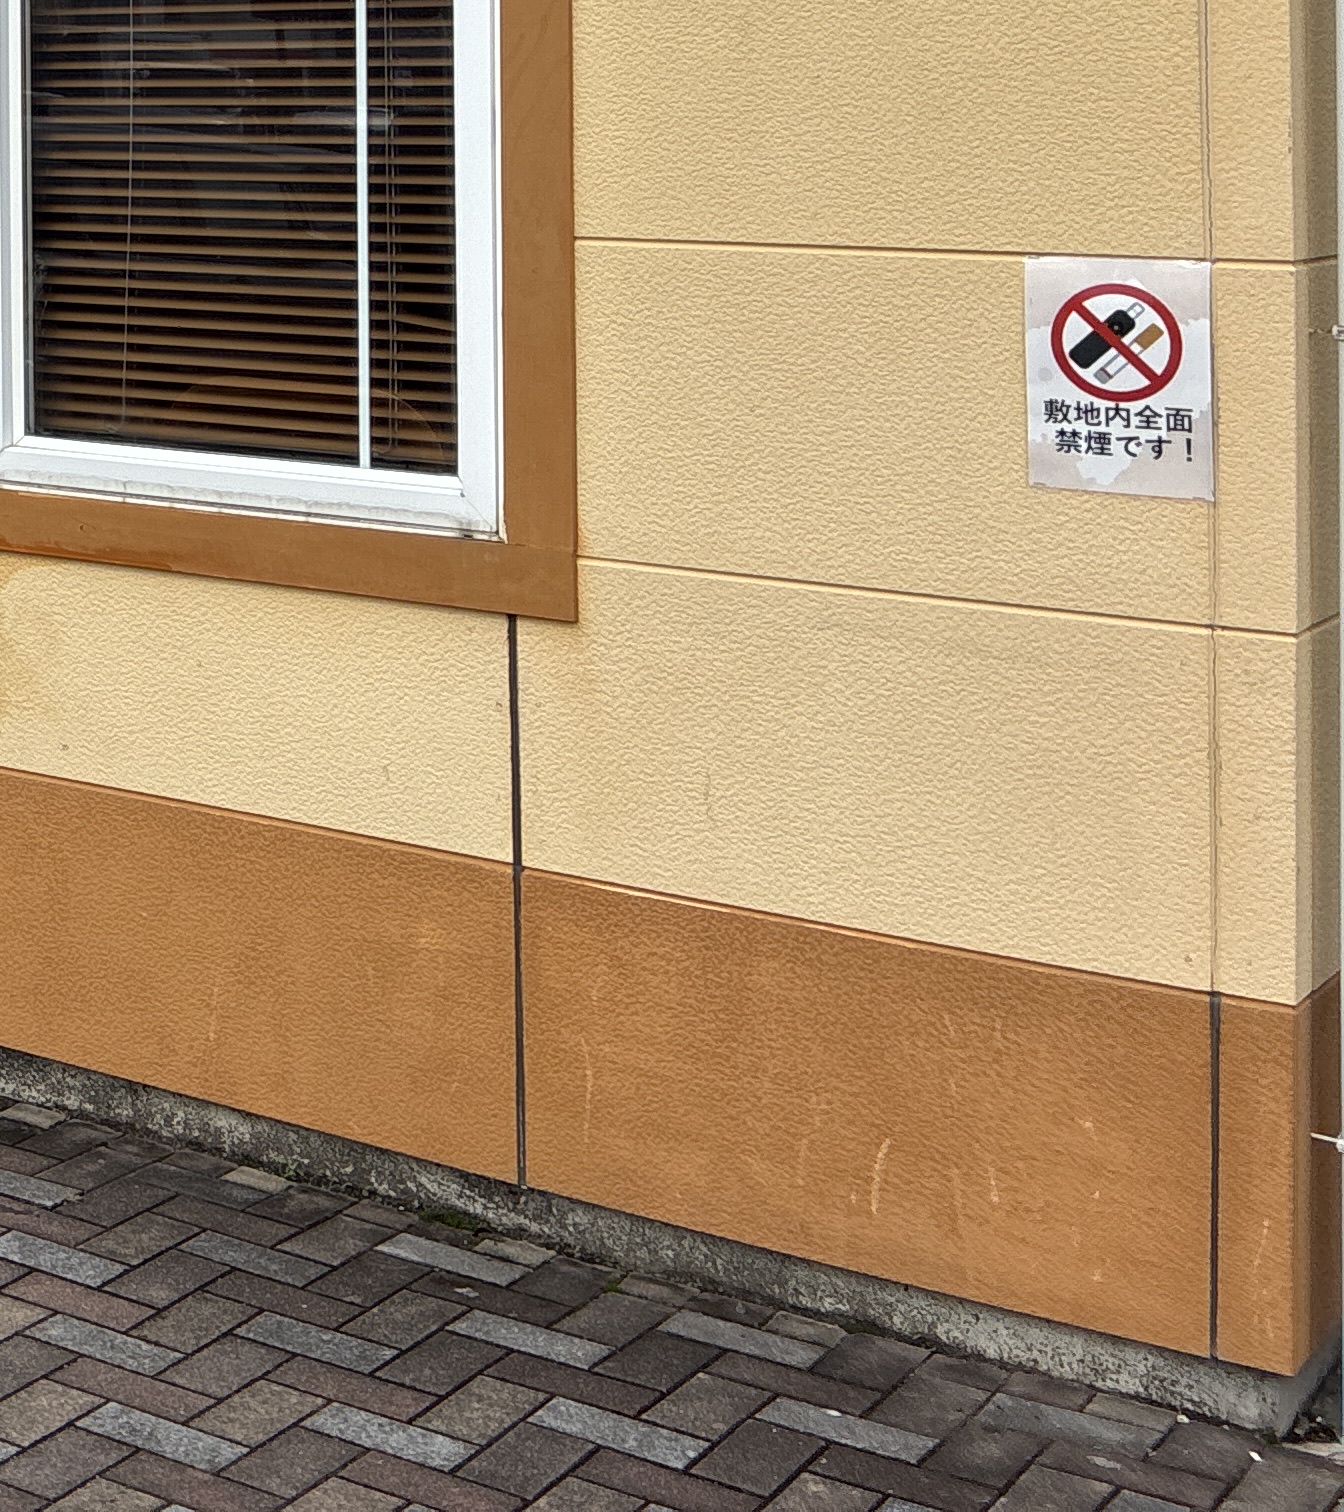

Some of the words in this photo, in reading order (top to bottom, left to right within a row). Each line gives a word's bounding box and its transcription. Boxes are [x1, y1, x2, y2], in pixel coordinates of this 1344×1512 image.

[1044, 398, 1193, 433] 敷地内全面
